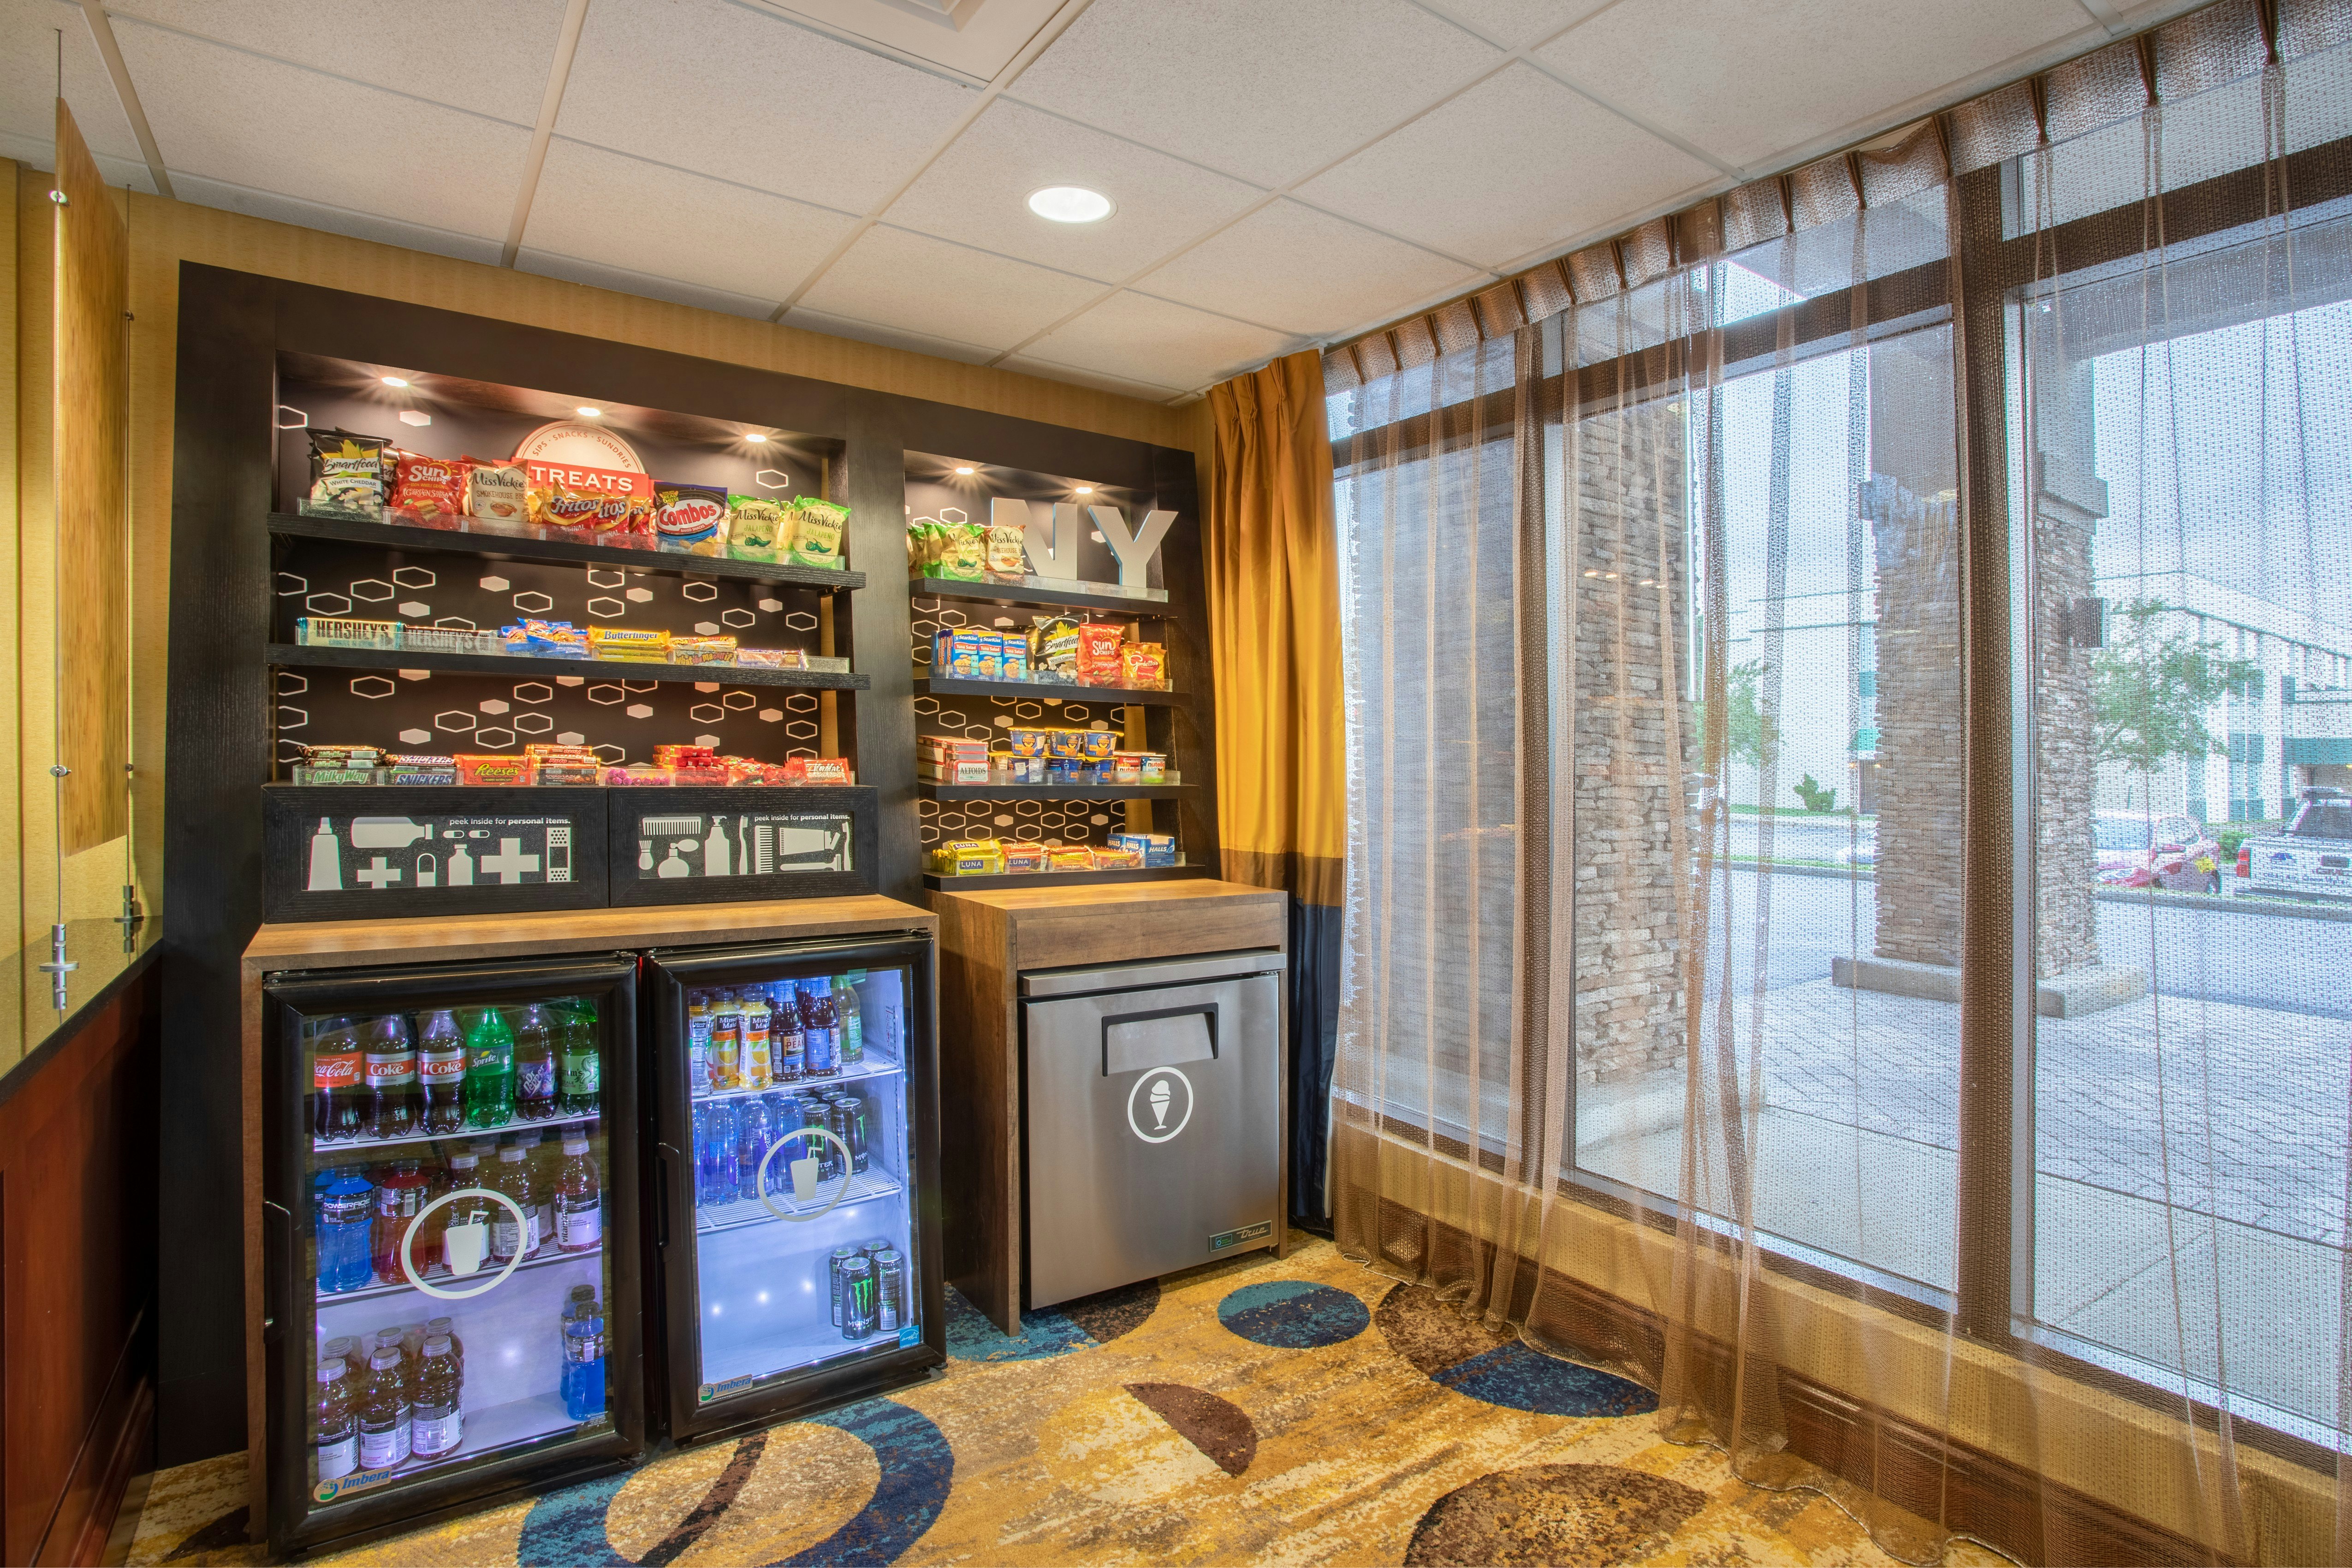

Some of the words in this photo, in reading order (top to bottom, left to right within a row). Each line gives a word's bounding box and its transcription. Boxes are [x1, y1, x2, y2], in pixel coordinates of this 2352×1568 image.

[533, 441, 547, 456] SIPS
[552, 431, 588, 441] SNACKS
[596, 436, 631, 469] SUNDRIES
[322, 457, 380, 473] Smartfood
[409, 465, 445, 482] Sun
[422, 476, 447, 485] CHIPS
[531, 466, 633, 492] TREATS
[476, 490, 513, 499] SMOKEHOUSE
[551, 495, 599, 514] Fritos
[598, 501, 626, 518] itos
[659, 503, 717, 526] Combos
[316, 620, 389, 639] HERSHEY'S
[604, 631, 657, 641] Butterfinger
[408, 629, 473, 649] HERSHEY'S
[1092, 641, 1113, 655] Sun
[1127, 655, 1158, 672] Gardetto's
[397, 775, 452, 784] SNICKERS
[786, 1038, 805, 1049] PEAK
[429, 1062, 461, 1075] Coke
[472, 1055, 497, 1068] Sprite
[370, 1064, 404, 1076] Coke
[525, 1070, 535, 1082] Dr
[523, 1064, 545, 1096] Pepper
[323, 1198, 371, 1209] POWERADE
[717, 1377, 751, 1392] Imbera
[342, 1470, 390, 1490] Imbera
